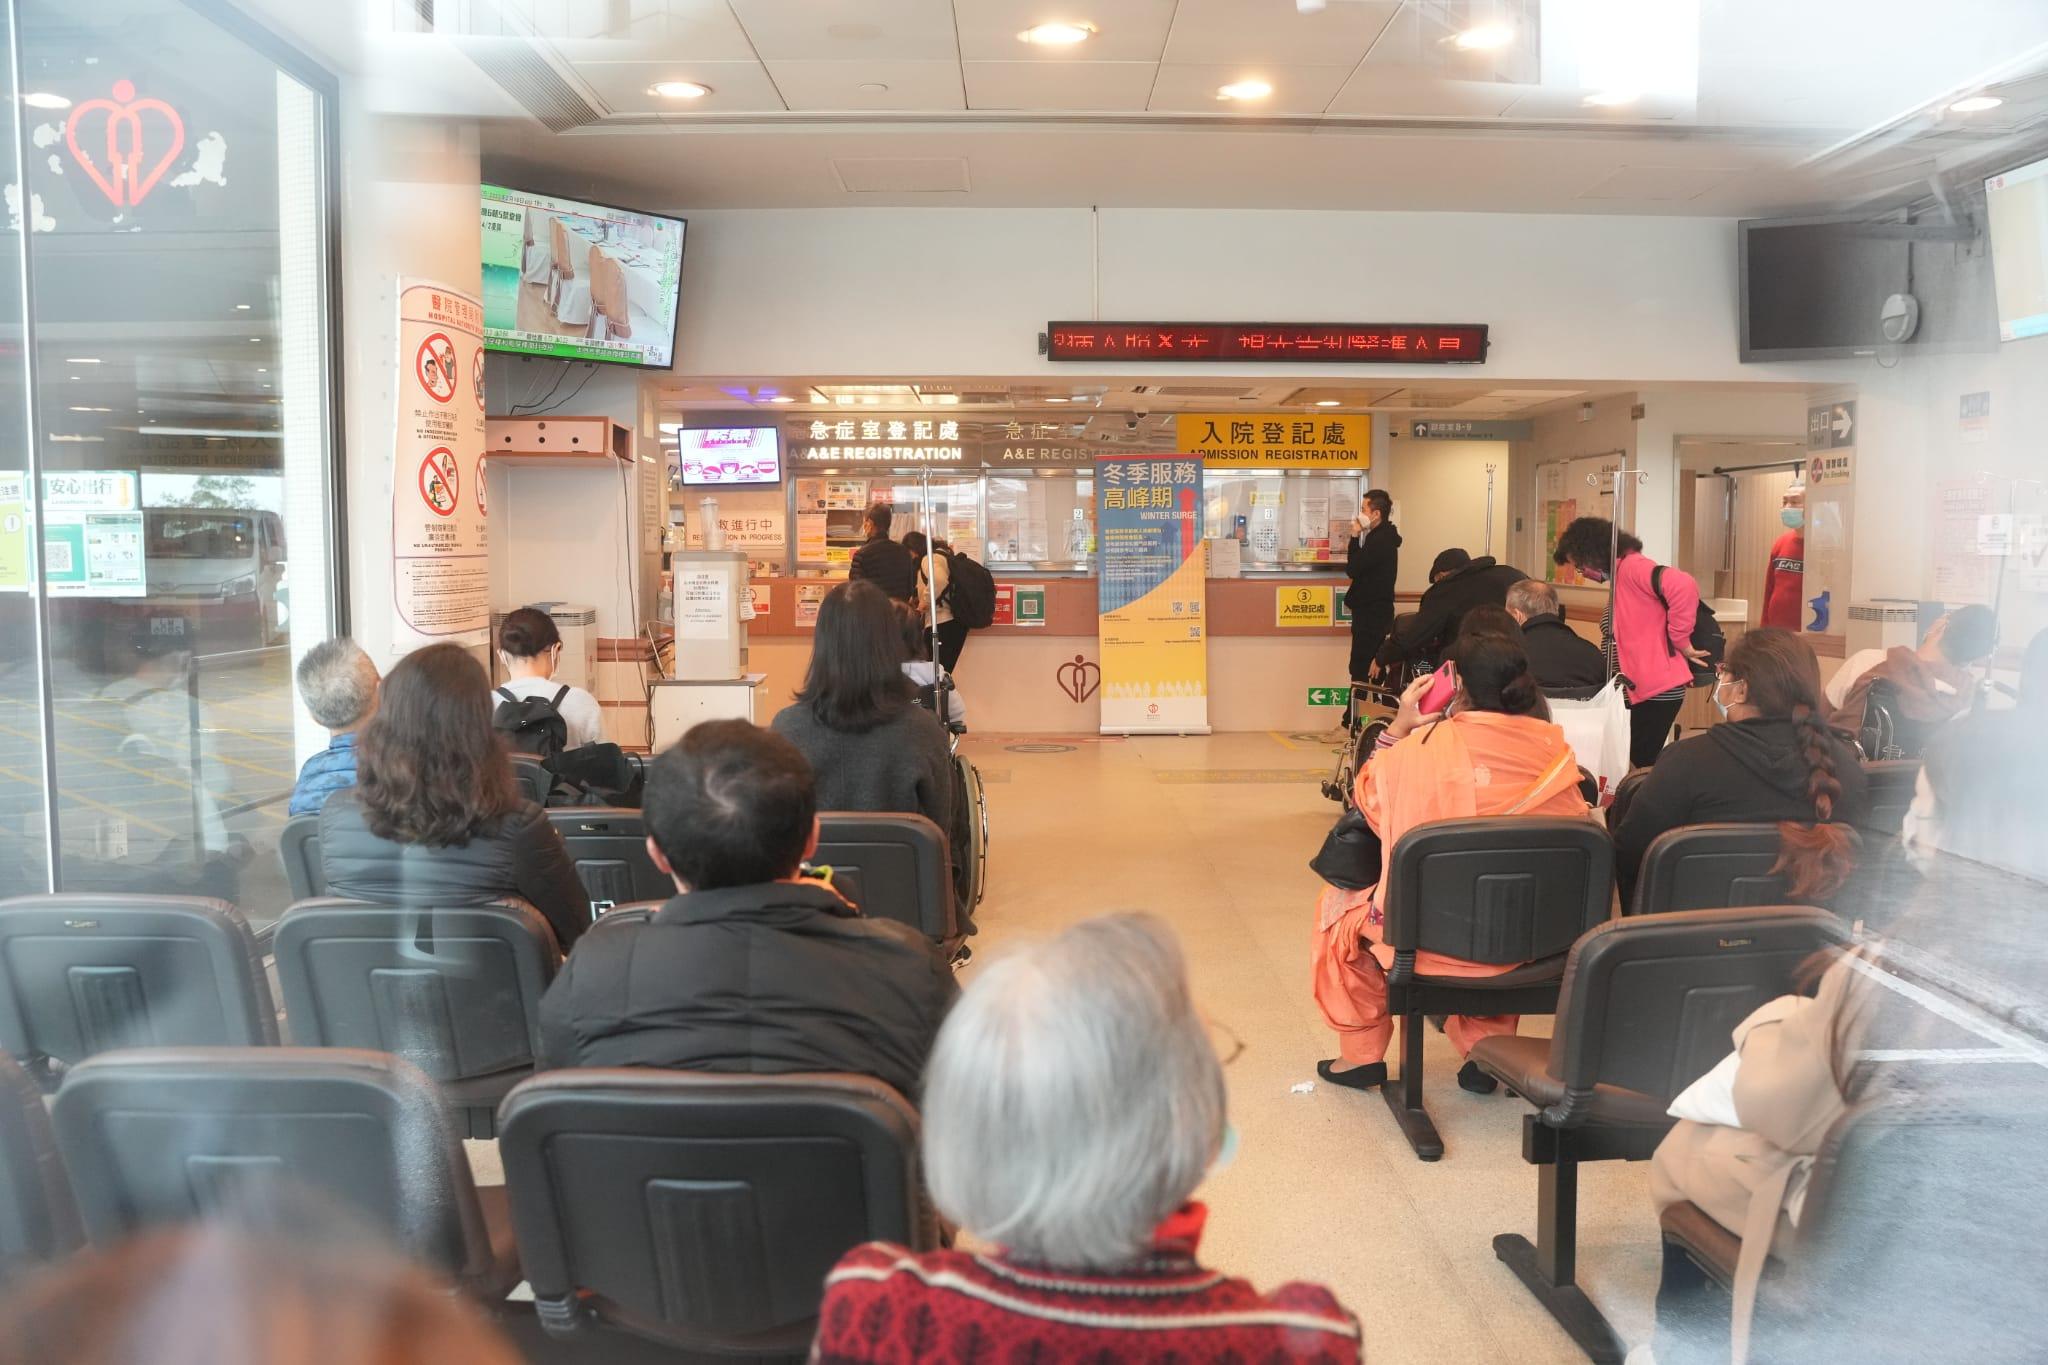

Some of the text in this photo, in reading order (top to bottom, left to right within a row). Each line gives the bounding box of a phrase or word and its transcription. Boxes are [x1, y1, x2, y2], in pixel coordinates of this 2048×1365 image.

[428, 311, 456, 325] HOSPITAL
[1811, 412, 1830, 432] 出口
[809, 421, 961, 442] 急症室登記處
[1200, 421, 1346, 446] 入院登記處
[806, 446, 962, 460] A&E REGISTRATION
[1003, 447, 1036, 460] A&E
[1265, 449, 1358, 461] REGISTRATION
[1103, 461, 1197, 485] 冬季服務
[50, 477, 113, 495] 安心出行
[1103, 487, 1173, 510] 高峰期
[1140, 511, 1198, 520] WINTER SURGE
[719, 518, 773, 532] 救進行中
[741, 533, 747, 542] IN
[749, 533, 783, 543] PROGRESS
[1283, 604, 1326, 614] 入院登記處
